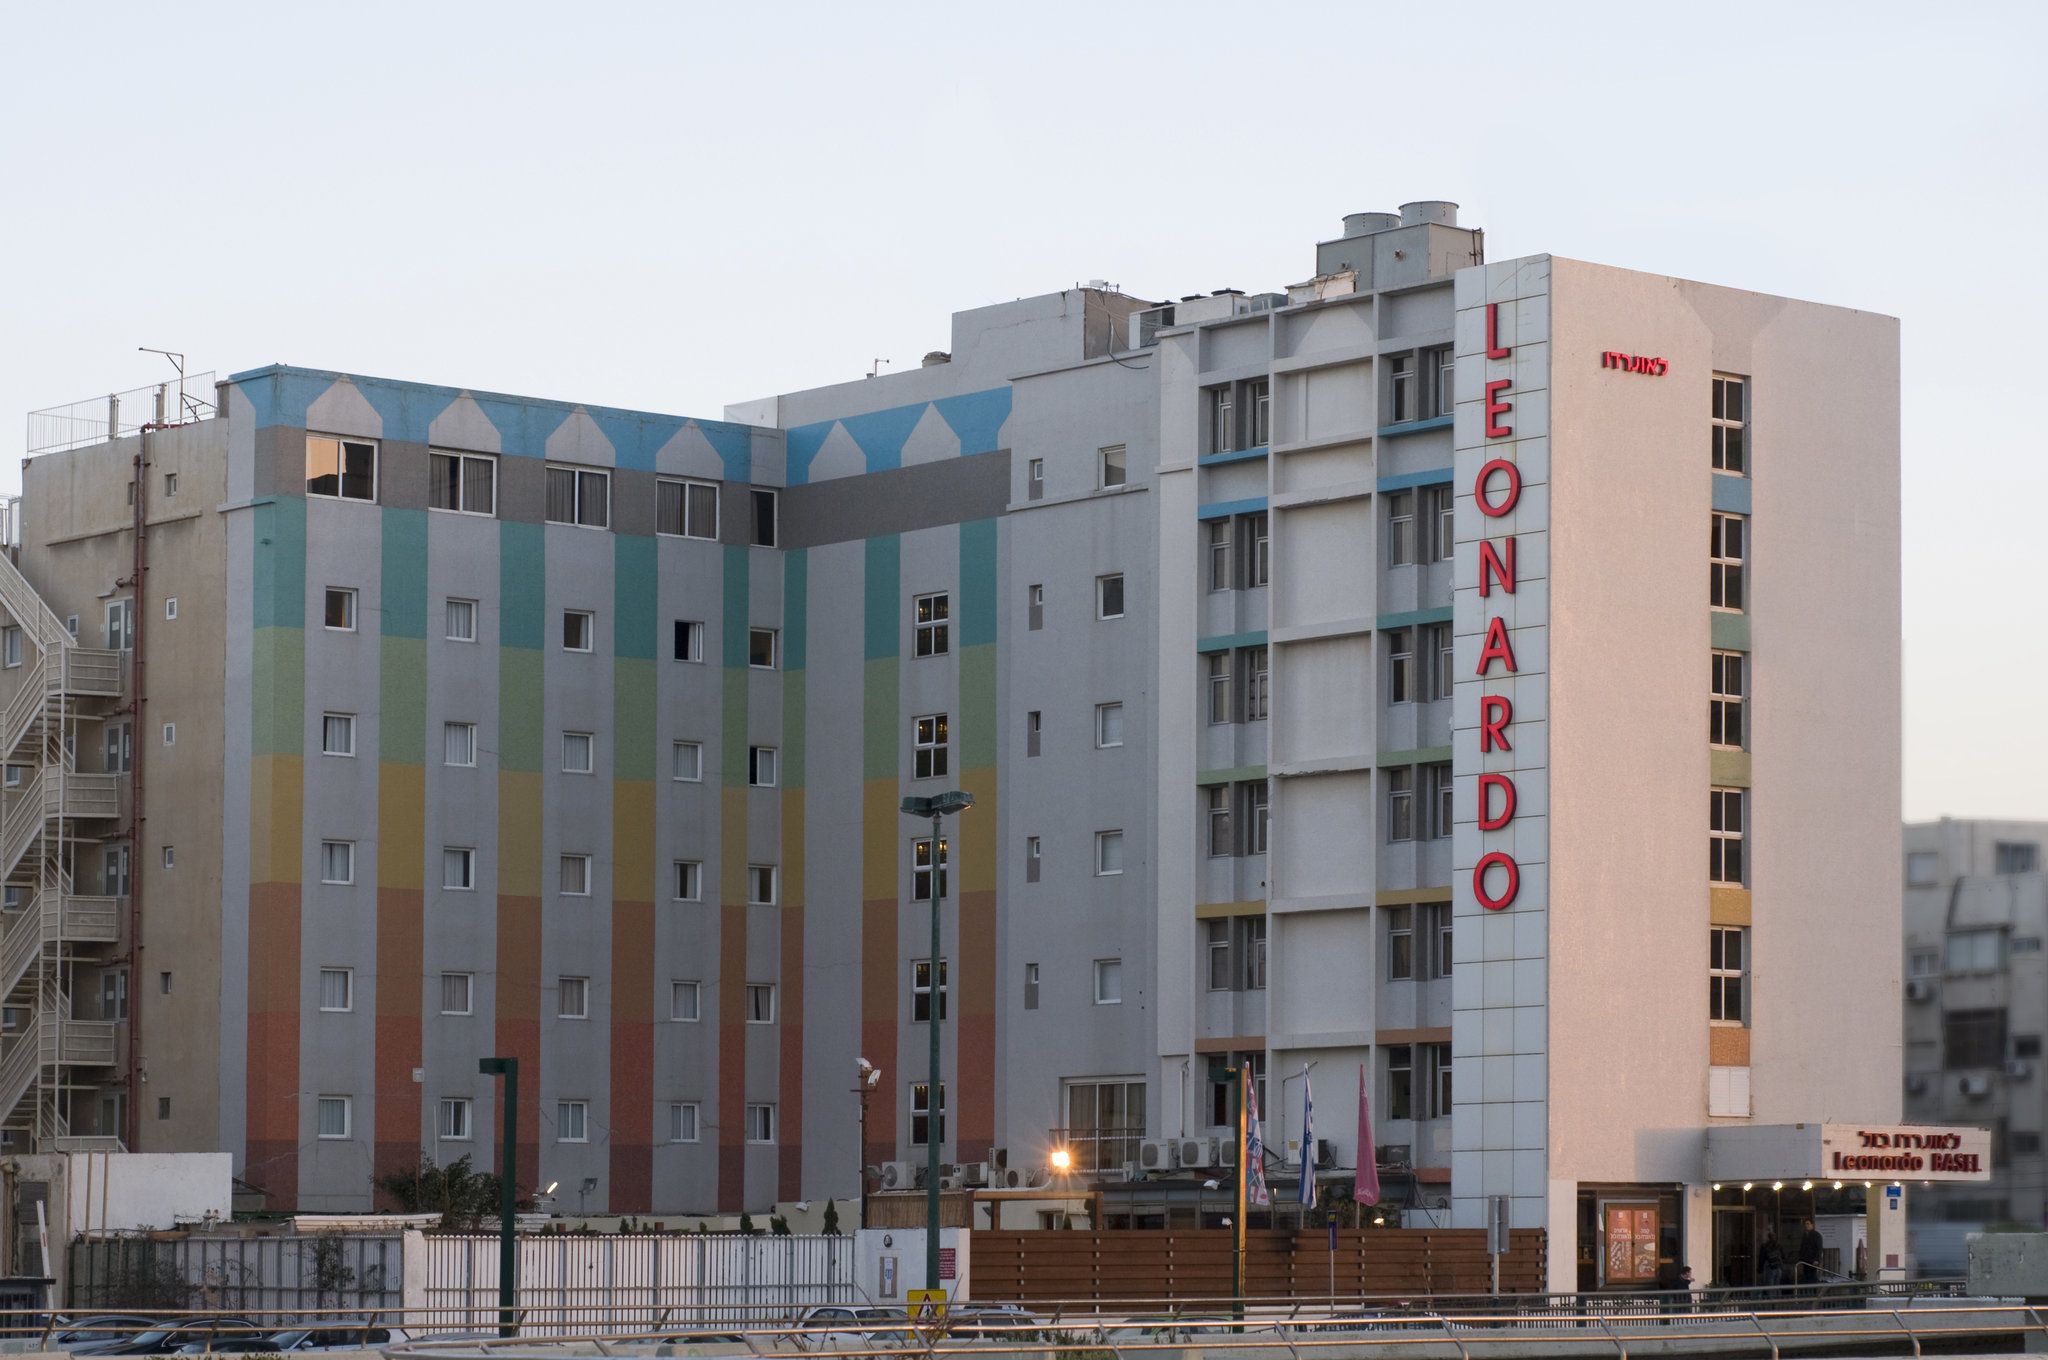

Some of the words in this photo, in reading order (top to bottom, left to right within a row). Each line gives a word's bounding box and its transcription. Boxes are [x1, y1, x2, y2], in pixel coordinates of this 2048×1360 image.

[1601, 351, 1669, 376] לאונרדו
[1473, 303, 1522, 911] LEONARDO
[1893, 1132, 1961, 1150] לאונרדו
[1833, 1151, 1924, 1171] Leonardo
[1930, 1152, 1982, 1173] BASEL
